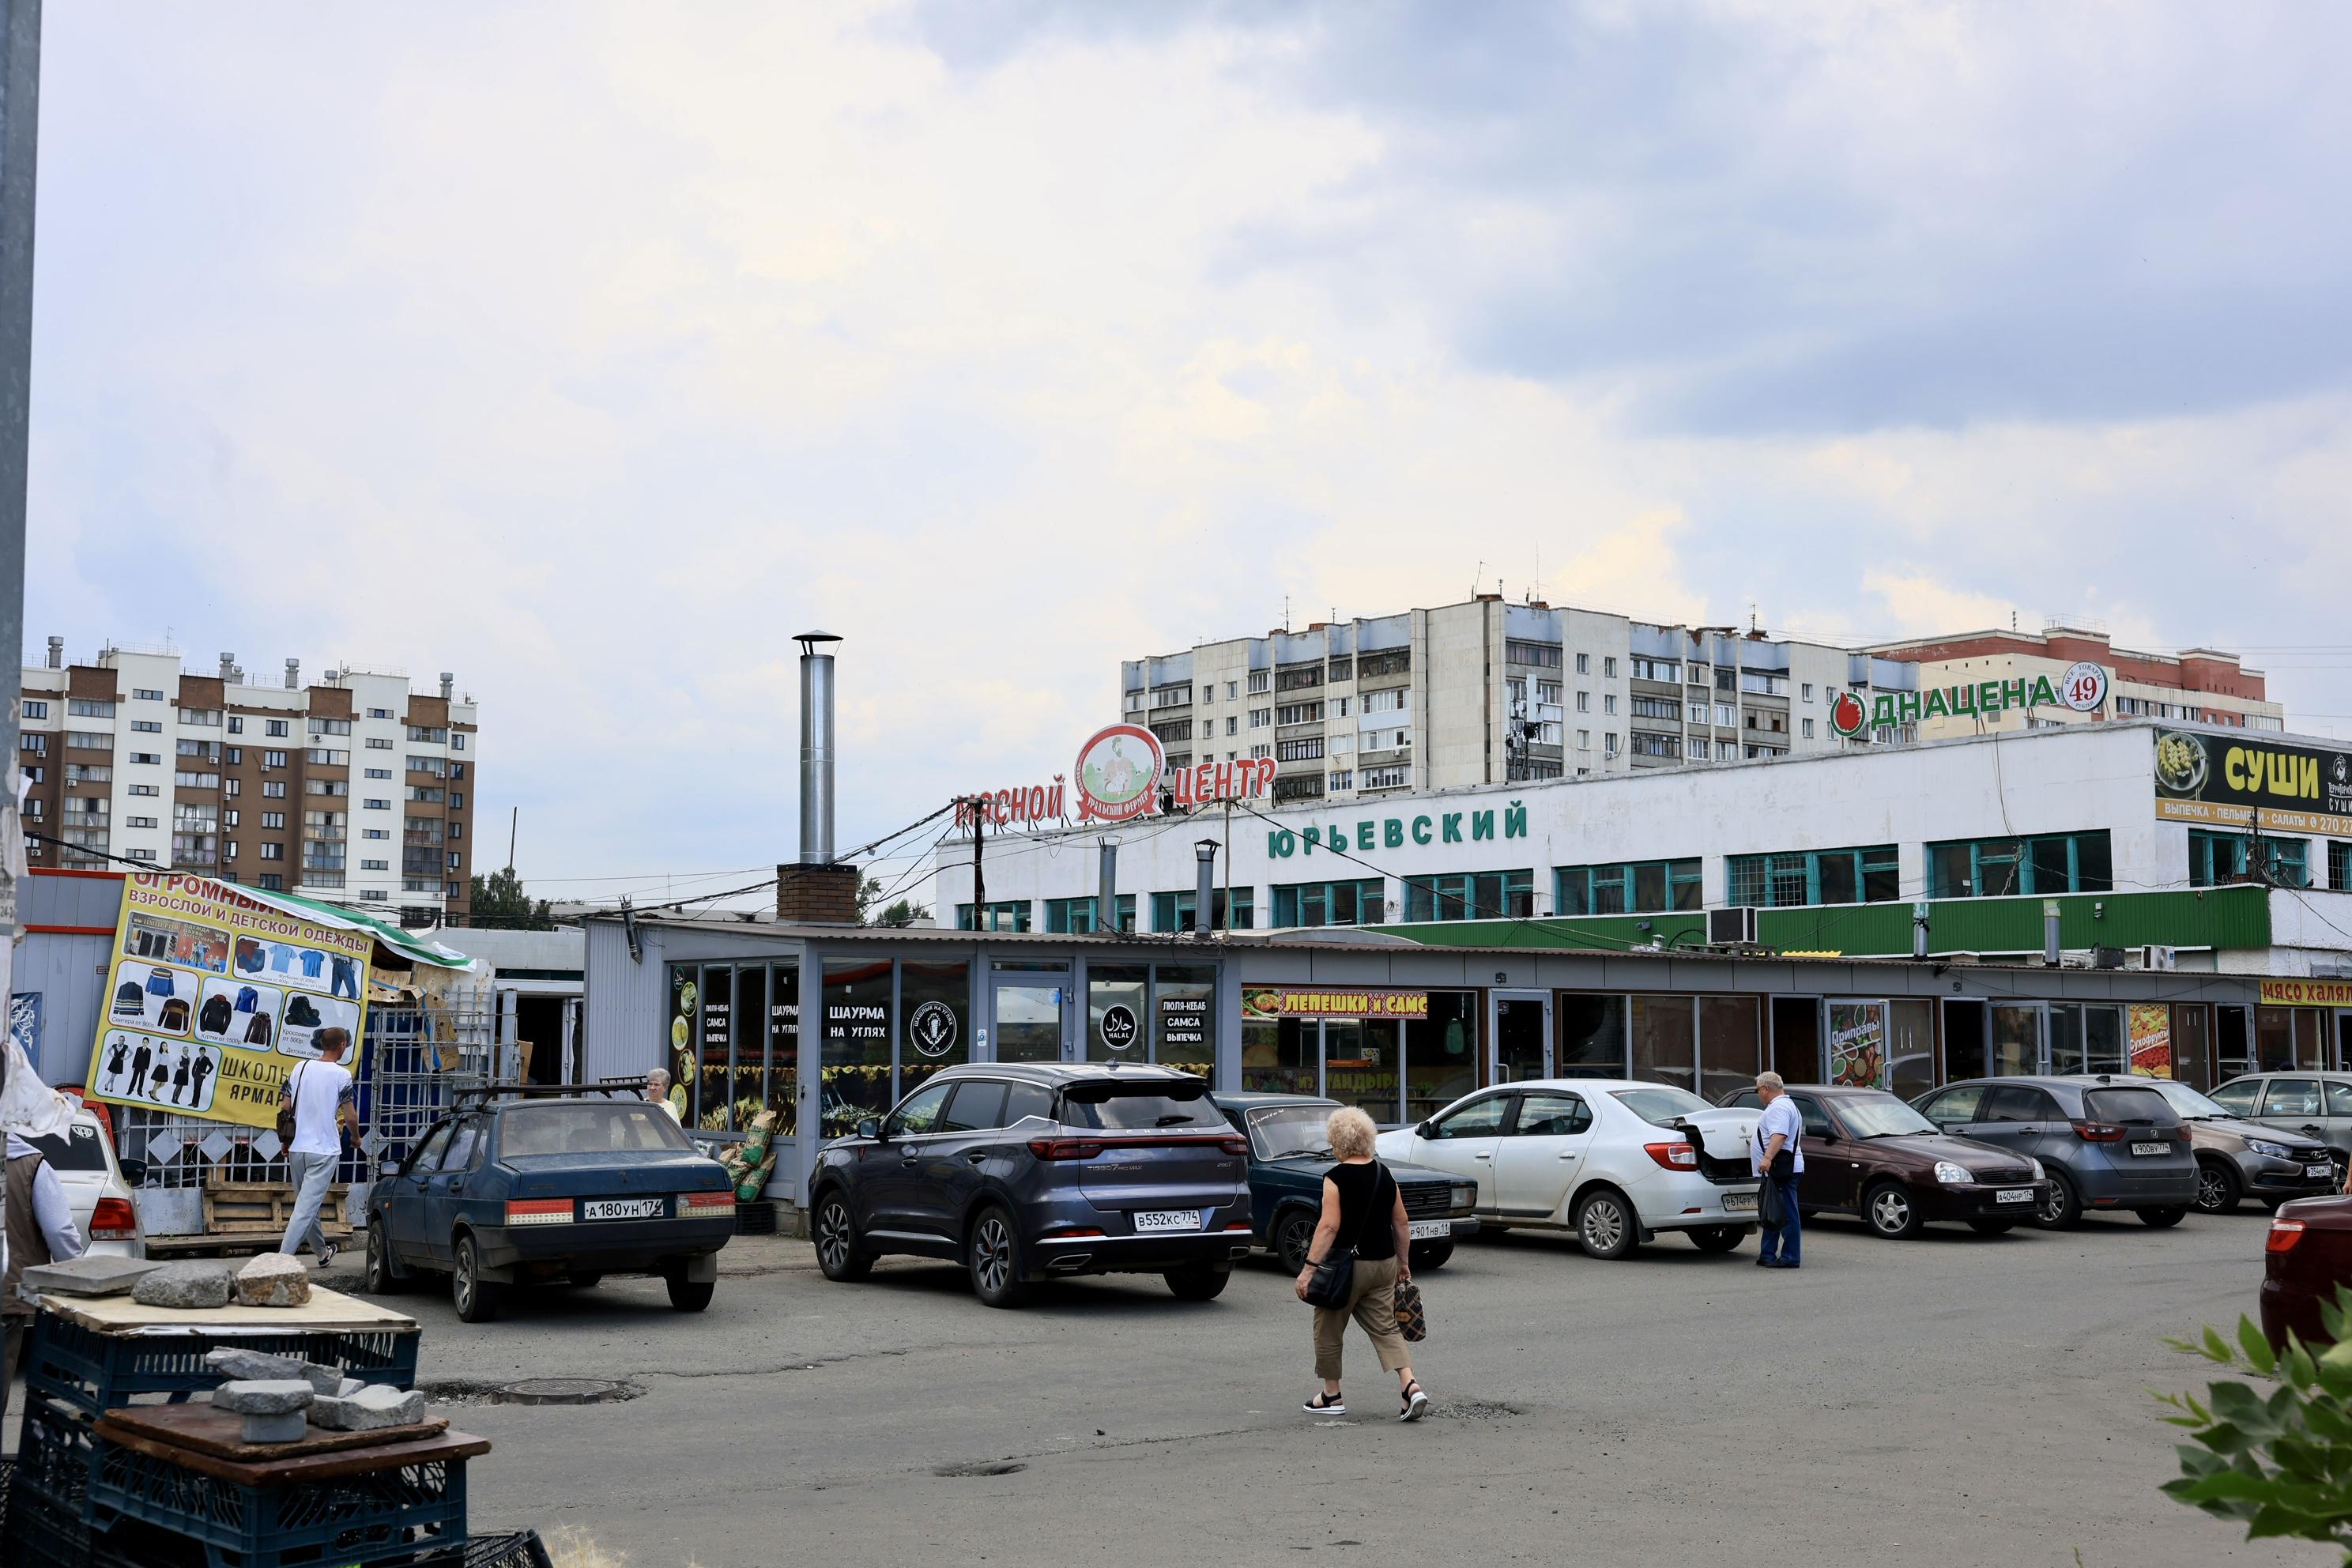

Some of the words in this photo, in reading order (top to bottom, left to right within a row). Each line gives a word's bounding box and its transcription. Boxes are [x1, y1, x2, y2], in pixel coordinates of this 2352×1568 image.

[2065, 670, 2075, 684] ВСЕ
[2078, 665, 2102, 680] ТОВАРЫ
[2069, 677, 2097, 702] 49
[2225, 746, 2319, 799] СУШИ
[1174, 756, 1278, 814] ЦЕНТР
[1087, 797, 1122, 816] УРАЛЬСКИЙ
[1124, 791, 1148, 813] ФЕРМЕР
[2165, 803, 2209, 817] ВЫПЕЧКА
[2272, 813, 2305, 827] САЛАТЫ
[2320, 816, 2339, 832] 270
[1268, 801, 1527, 858] ЮРЬЕВСКИЙ
[130, 889, 212, 917] ВЗРОСЛОЙ
[216, 908, 227, 921] И
[230, 912, 299, 937] ДЕТСКОЙ
[304, 928, 369, 952] ОДЕЖДЫ
[184, 924, 210, 933] ОДЕЖДА
[771, 1005, 799, 1016] ШАУРМА
[1163, 1001, 1206, 1011] ЛЮЛЯ-КЕБАБ
[1283, 994, 1368, 1012] ЛЕПЕШКИ
[111, 1016, 134, 1025] Свитера
[829, 1006, 884, 1020] ШАУРМА
[914, 1005, 933, 1027] ШАШЛЫК
[942, 1008, 953, 1026] УГЛЯХ
[1106, 1013, 1132, 1031] حلال
[707, 1018, 726, 1027] САМСА
[771, 1025, 779, 1034] НА
[782, 1025, 799, 1034] УГЛЯХ
[1167, 1018, 1200, 1027] САМСА
[283, 1029, 311, 1038] Кроссовки
[707, 1034, 727, 1042] ВЫПЕЧКА
[830, 1027, 845, 1037] НА
[851, 1027, 885, 1037] УГЛЯХ
[1167, 1033, 1201, 1042] ВЫПЕЧКА
[1832, 1020, 1879, 1046] Приправы
[2130, 1030, 2169, 1051] Сухофрукты
[221, 1057, 288, 1085] ШКОЛЬ
[229, 1084, 284, 1106] ЯРМАР
